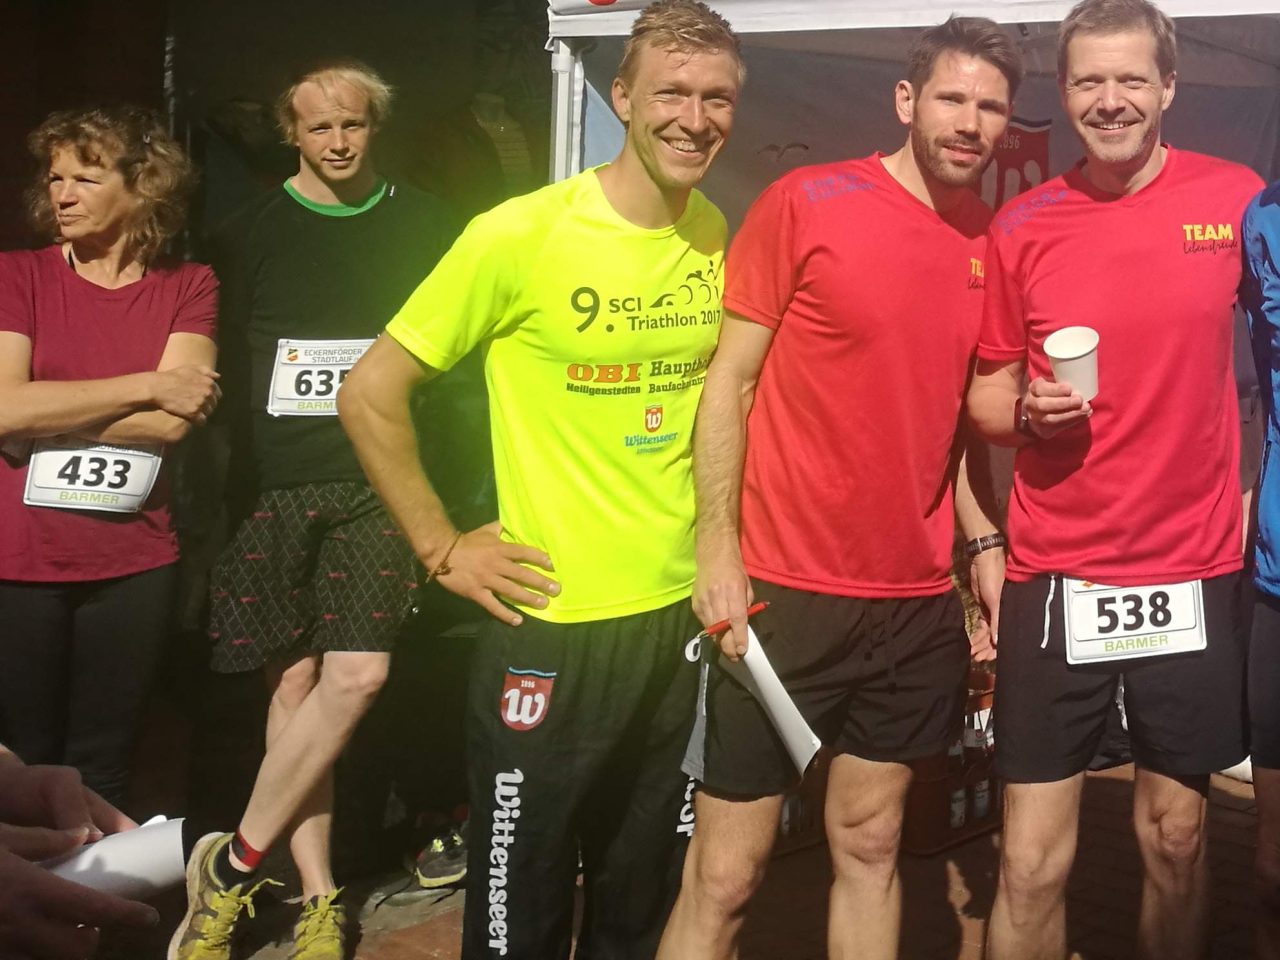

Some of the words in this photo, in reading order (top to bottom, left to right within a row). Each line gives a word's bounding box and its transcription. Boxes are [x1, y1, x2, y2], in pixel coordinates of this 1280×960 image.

[1182, 223, 1234, 241] TEAM
[570, 286, 615, 334] 9.
[608, 297, 642, 314] SCI
[626, 313, 698, 332] Triathlon
[304, 347, 363, 358] ECKERNFÖRDER
[311, 355, 353, 364] STADTLAUF
[566, 362, 643, 384] OBI
[565, 382, 641, 396] Heiligenstedten
[624, 432, 678, 447] Wittenseer
[57, 455, 132, 490] 433
[58, 491, 121, 505] BARMER
[1096, 590, 1172, 635] 538
[1103, 634, 1169, 653] BARMER
[488, 767, 525, 957] Wittenseer
